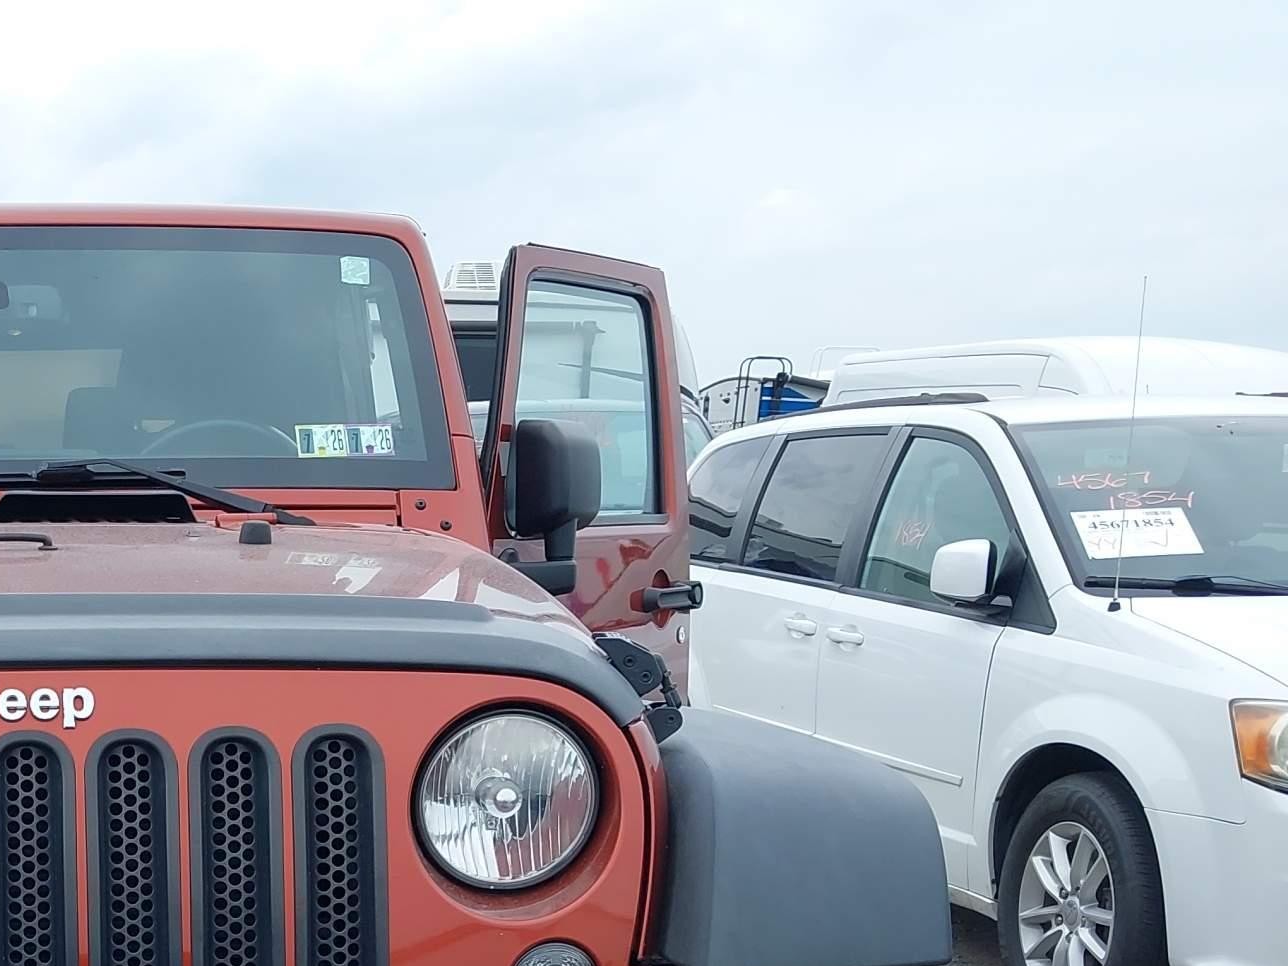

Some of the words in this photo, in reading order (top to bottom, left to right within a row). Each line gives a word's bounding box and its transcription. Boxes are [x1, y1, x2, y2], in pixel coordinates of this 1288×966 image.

[1056, 472, 1151, 489] 4567
[1109, 490, 1195, 510] 1854
[1088, 518, 1175, 530] 45671854
